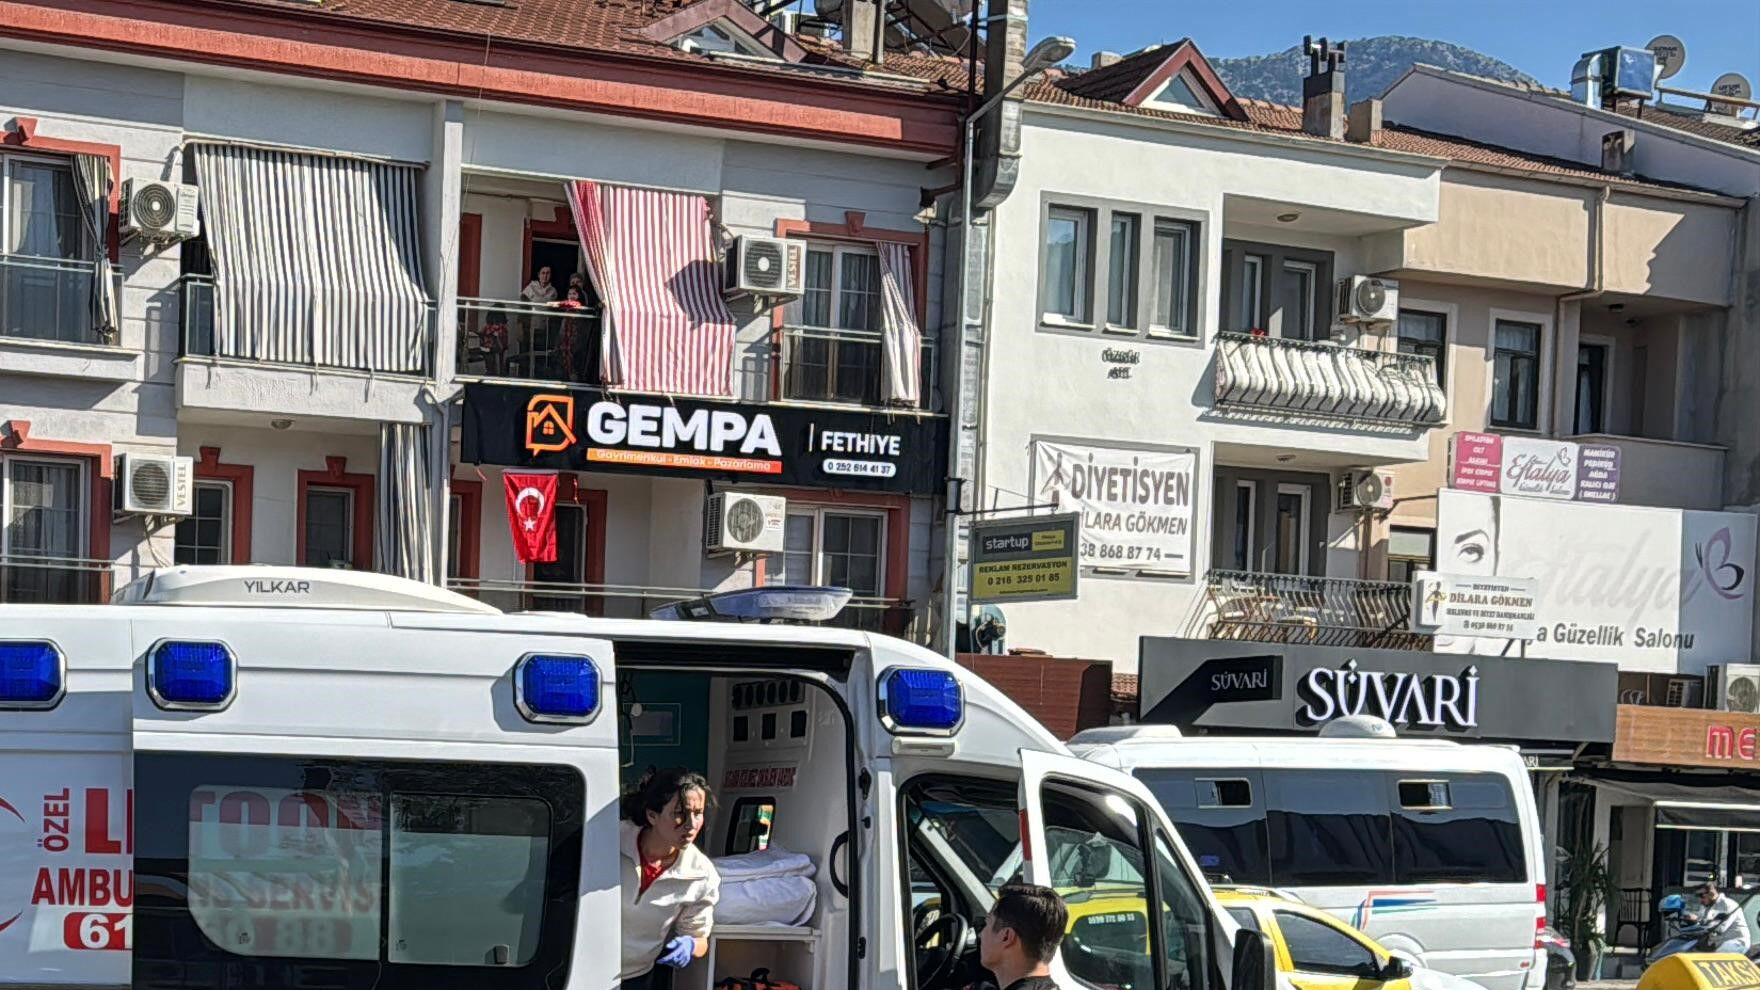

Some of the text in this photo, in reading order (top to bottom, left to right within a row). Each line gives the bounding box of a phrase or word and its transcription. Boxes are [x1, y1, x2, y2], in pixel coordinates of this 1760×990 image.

[587, 401, 782, 457] GEMPA
[1071, 453, 1190, 507] DİYETİSYEN
[1125, 512, 1188, 535] GÖKMEN
[986, 536, 1029, 550] startup
[1100, 544, 1123, 560] 868
[1127, 546, 1142, 560] 87
[1146, 547, 1161, 561] 74
[979, 564, 1010, 573] REKLAM
[987, 577, 993, 585] 0
[244, 580, 310, 594] YILKAR
[1554, 622, 1624, 647] Güzellik
[1633, 627, 1695, 650] Salonu
[1210, 667, 1267, 692] SÜVARİ
[1306, 658, 1480, 728] SÜVARİ
[37, 787, 70, 852] ÖZEL
[31, 867, 133, 907] AMBU
